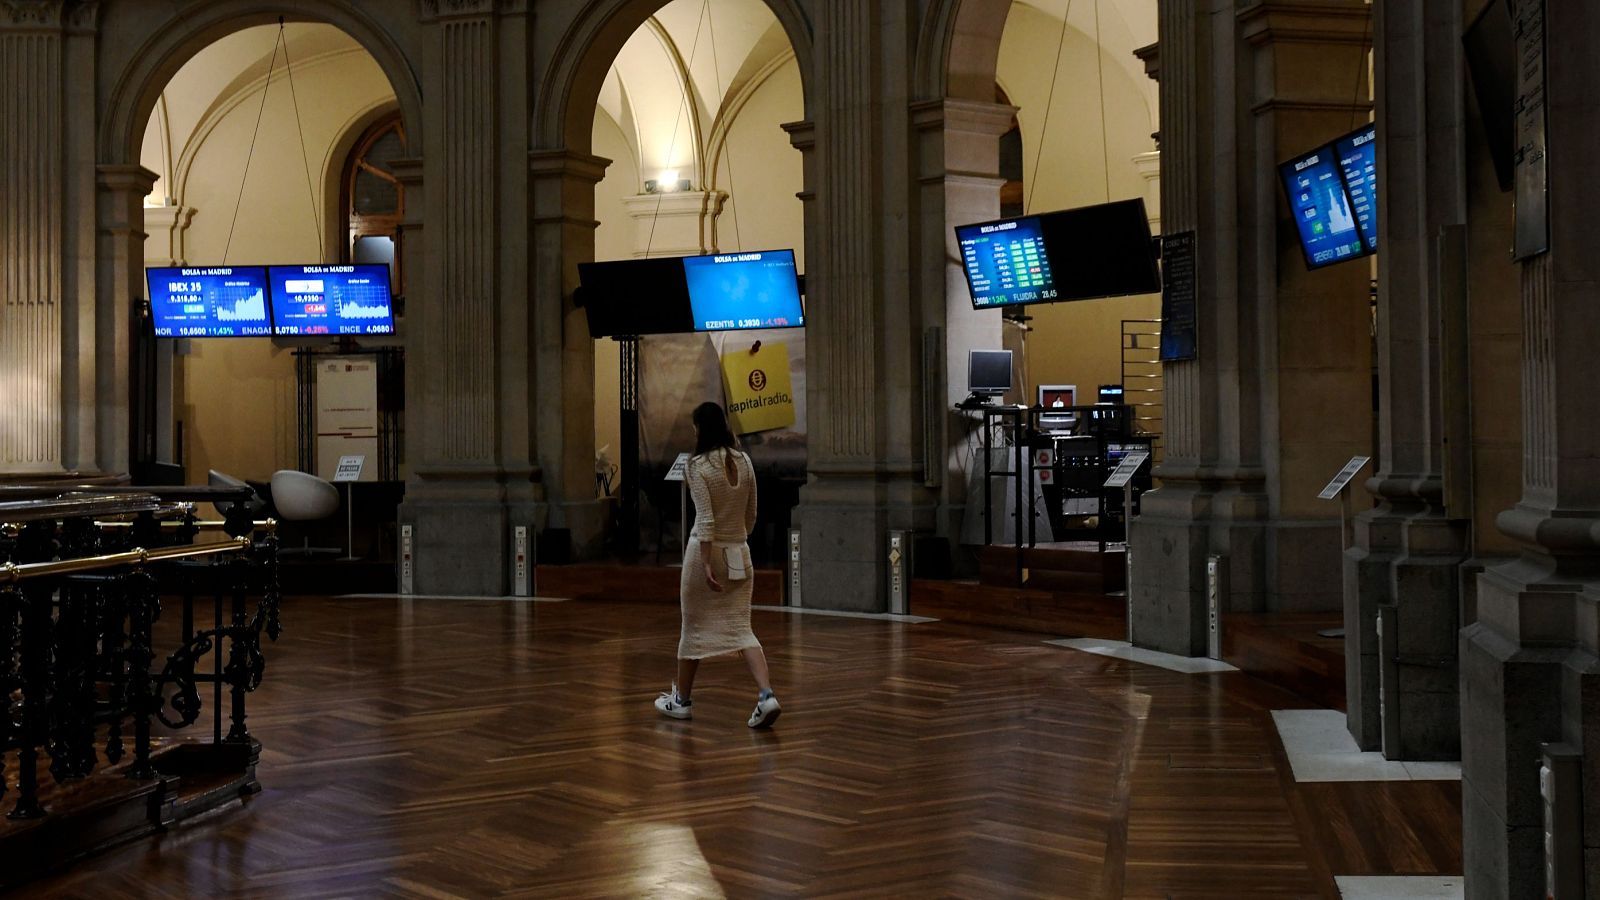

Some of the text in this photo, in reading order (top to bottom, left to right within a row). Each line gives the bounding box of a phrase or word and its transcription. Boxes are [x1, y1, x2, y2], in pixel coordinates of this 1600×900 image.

[714, 255, 732, 263] BOLSA
[739, 254, 761, 262] MADRID
[208, 268, 232, 276] MADRID
[169, 282, 202, 292] IBEX 35
[1013, 292, 1037, 301] FLUIDRA
[155, 327, 172, 336] NOR
[339, 325, 361, 333] ENCE
